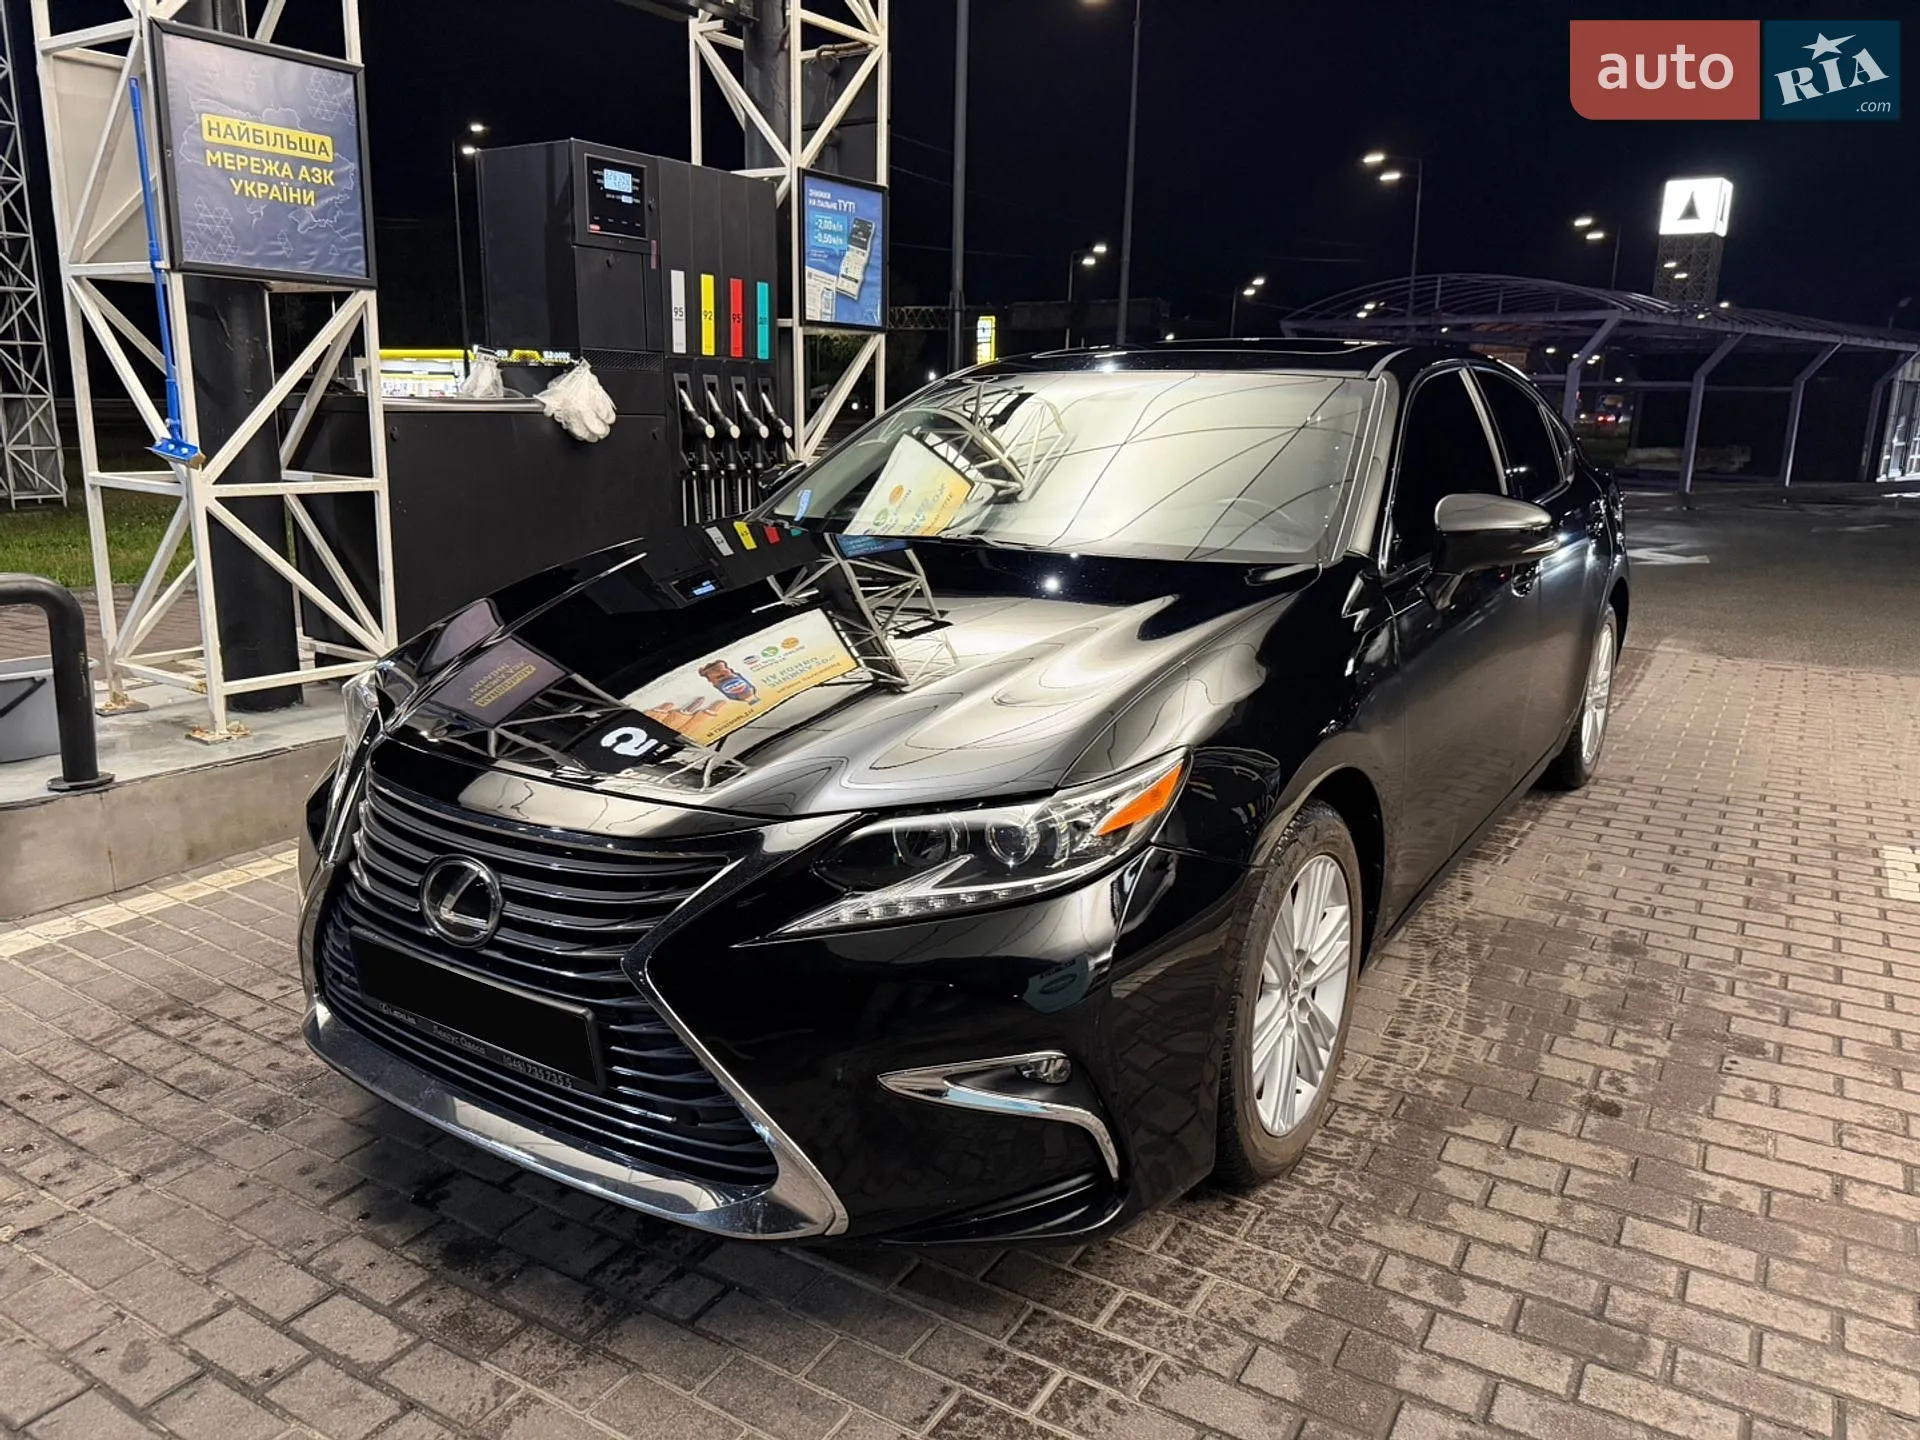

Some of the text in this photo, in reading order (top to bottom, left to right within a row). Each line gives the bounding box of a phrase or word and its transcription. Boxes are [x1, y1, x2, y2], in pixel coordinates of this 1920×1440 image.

[206, 119, 331, 158] НАЙБІЛЬША
[205, 148, 336, 187] МЕРЕЖА АЗК
[229, 176, 316, 207] УКРАЇНИ
[673, 306, 684, 317] 95
[703, 309, 714, 321] 92
